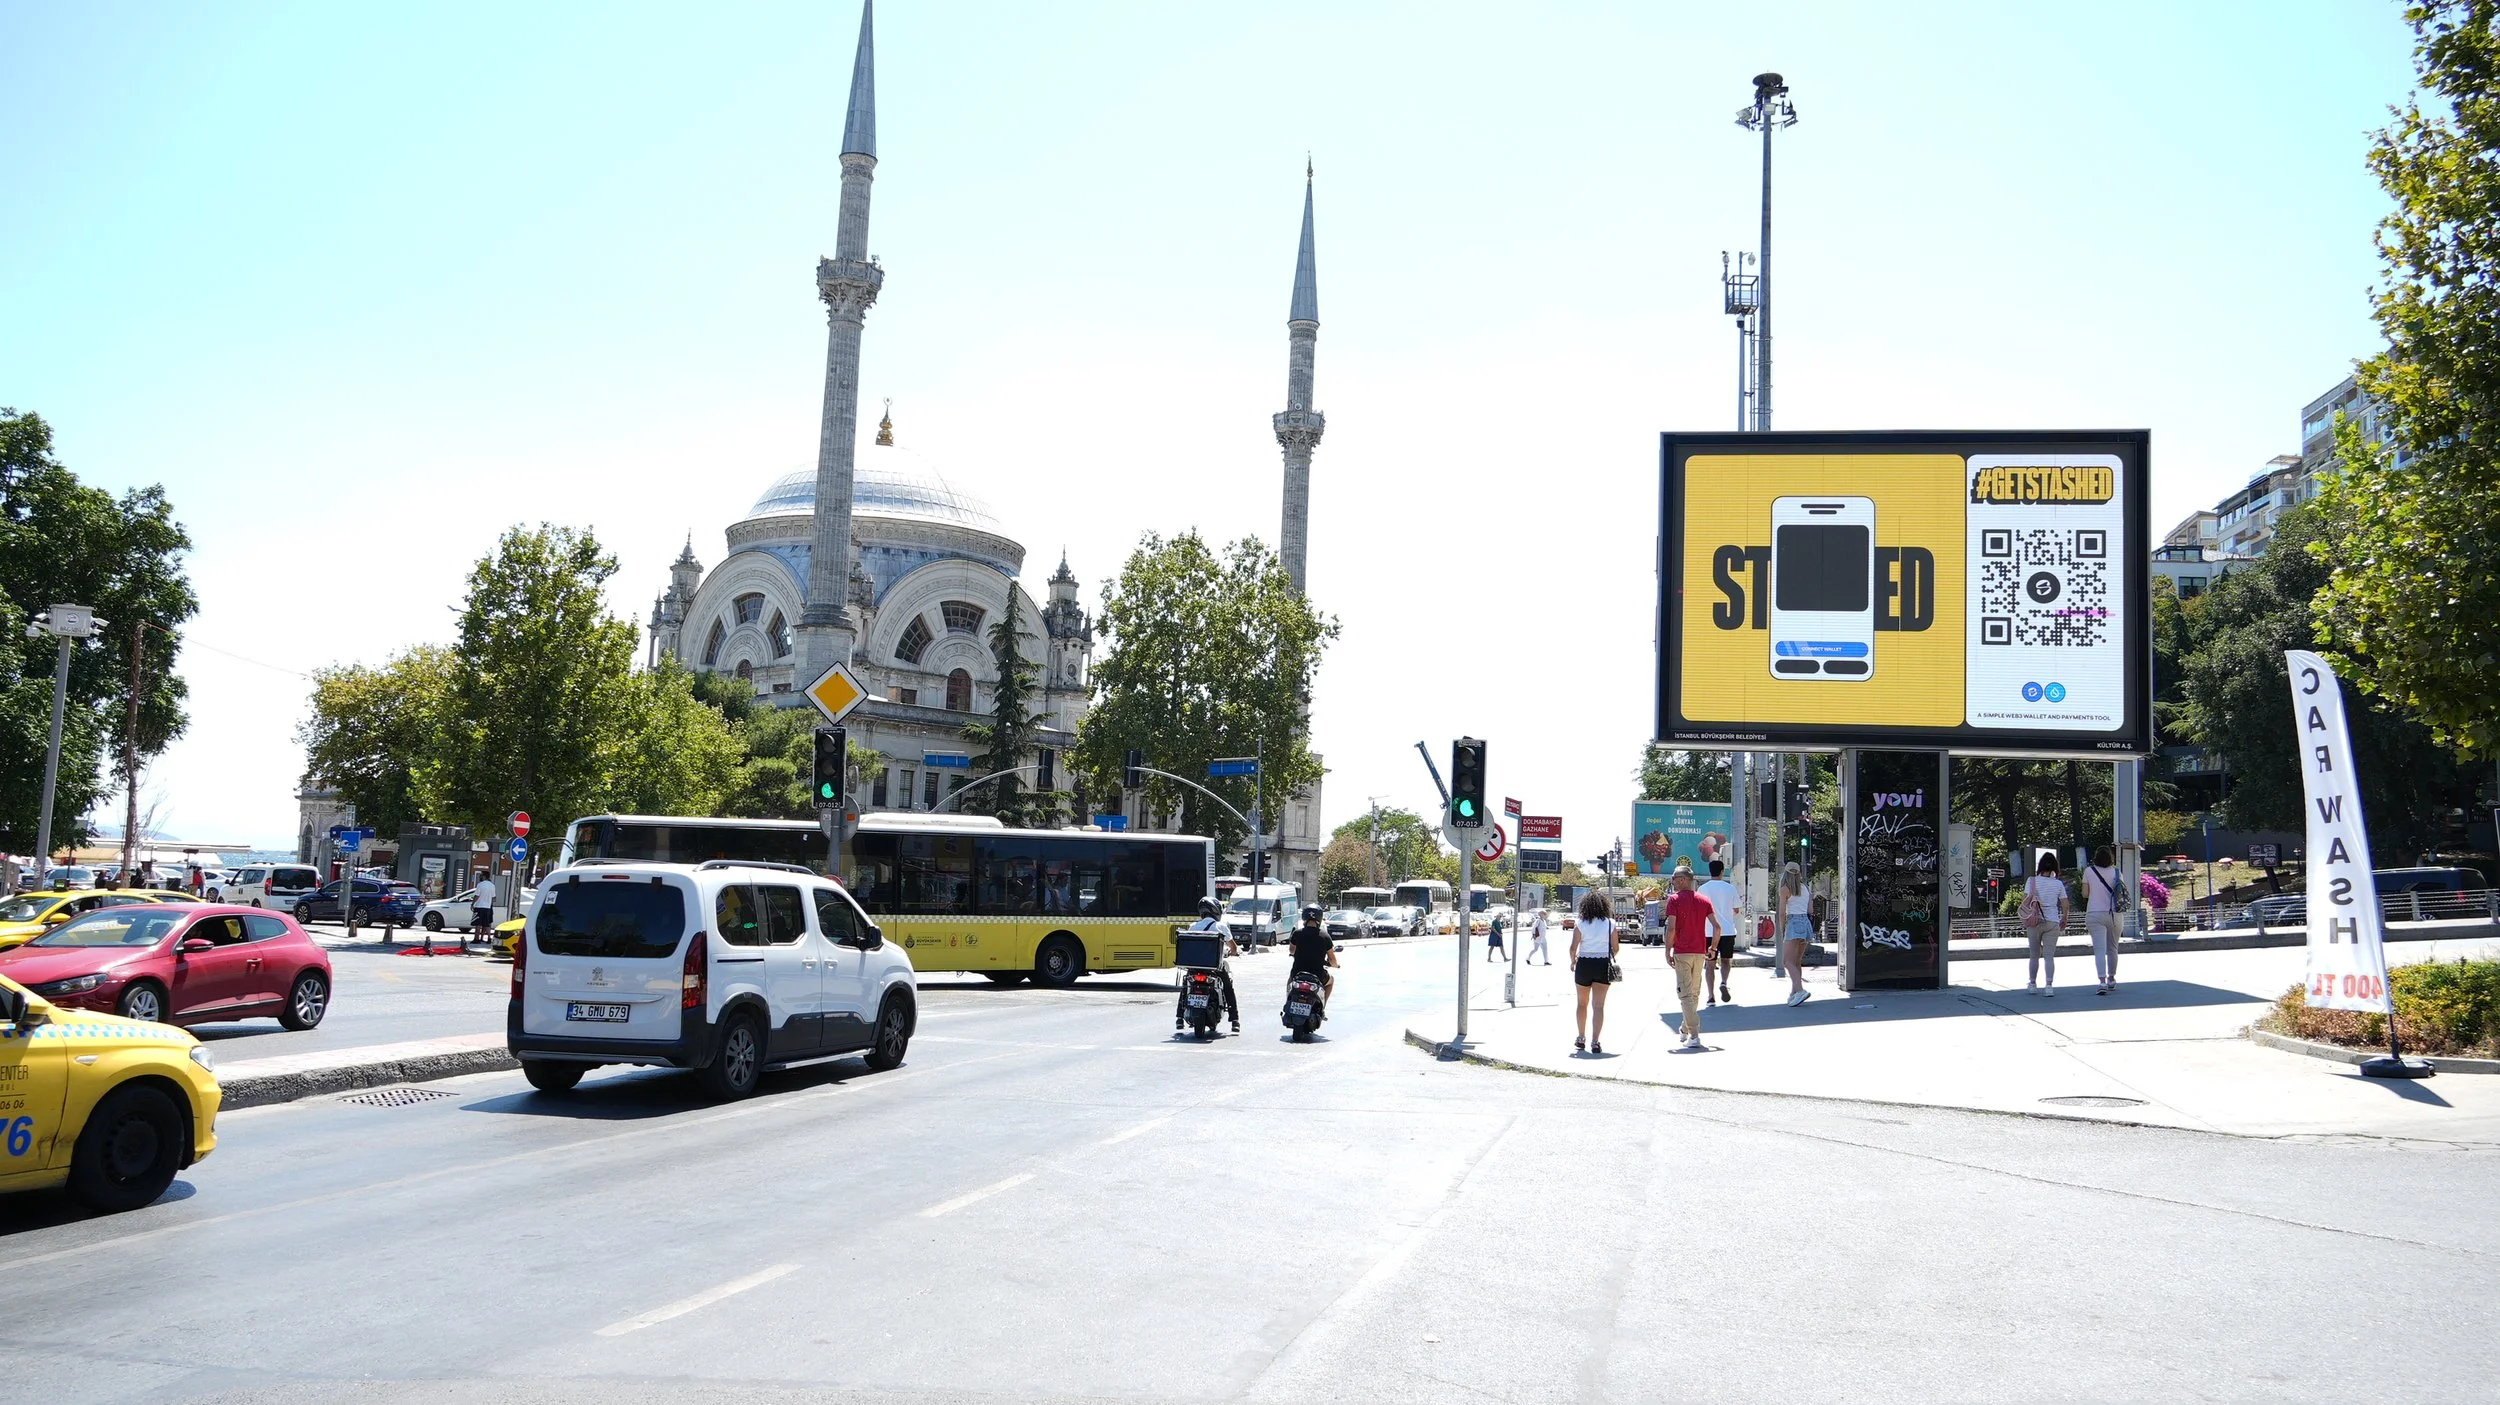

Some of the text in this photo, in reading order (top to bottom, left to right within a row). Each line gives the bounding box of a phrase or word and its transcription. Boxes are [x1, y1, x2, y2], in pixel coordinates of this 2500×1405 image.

[1972, 466, 2113, 503] #GETSTASHED
[2096, 741, 2120, 749] KÜLTÜR
[1872, 788, 1923, 812] yovi
[1522, 818, 1561, 826] DOLMABAHÇE
[573, 1005, 627, 1018] 34 GMU 679
[13, 1099, 25, 1109] 06
